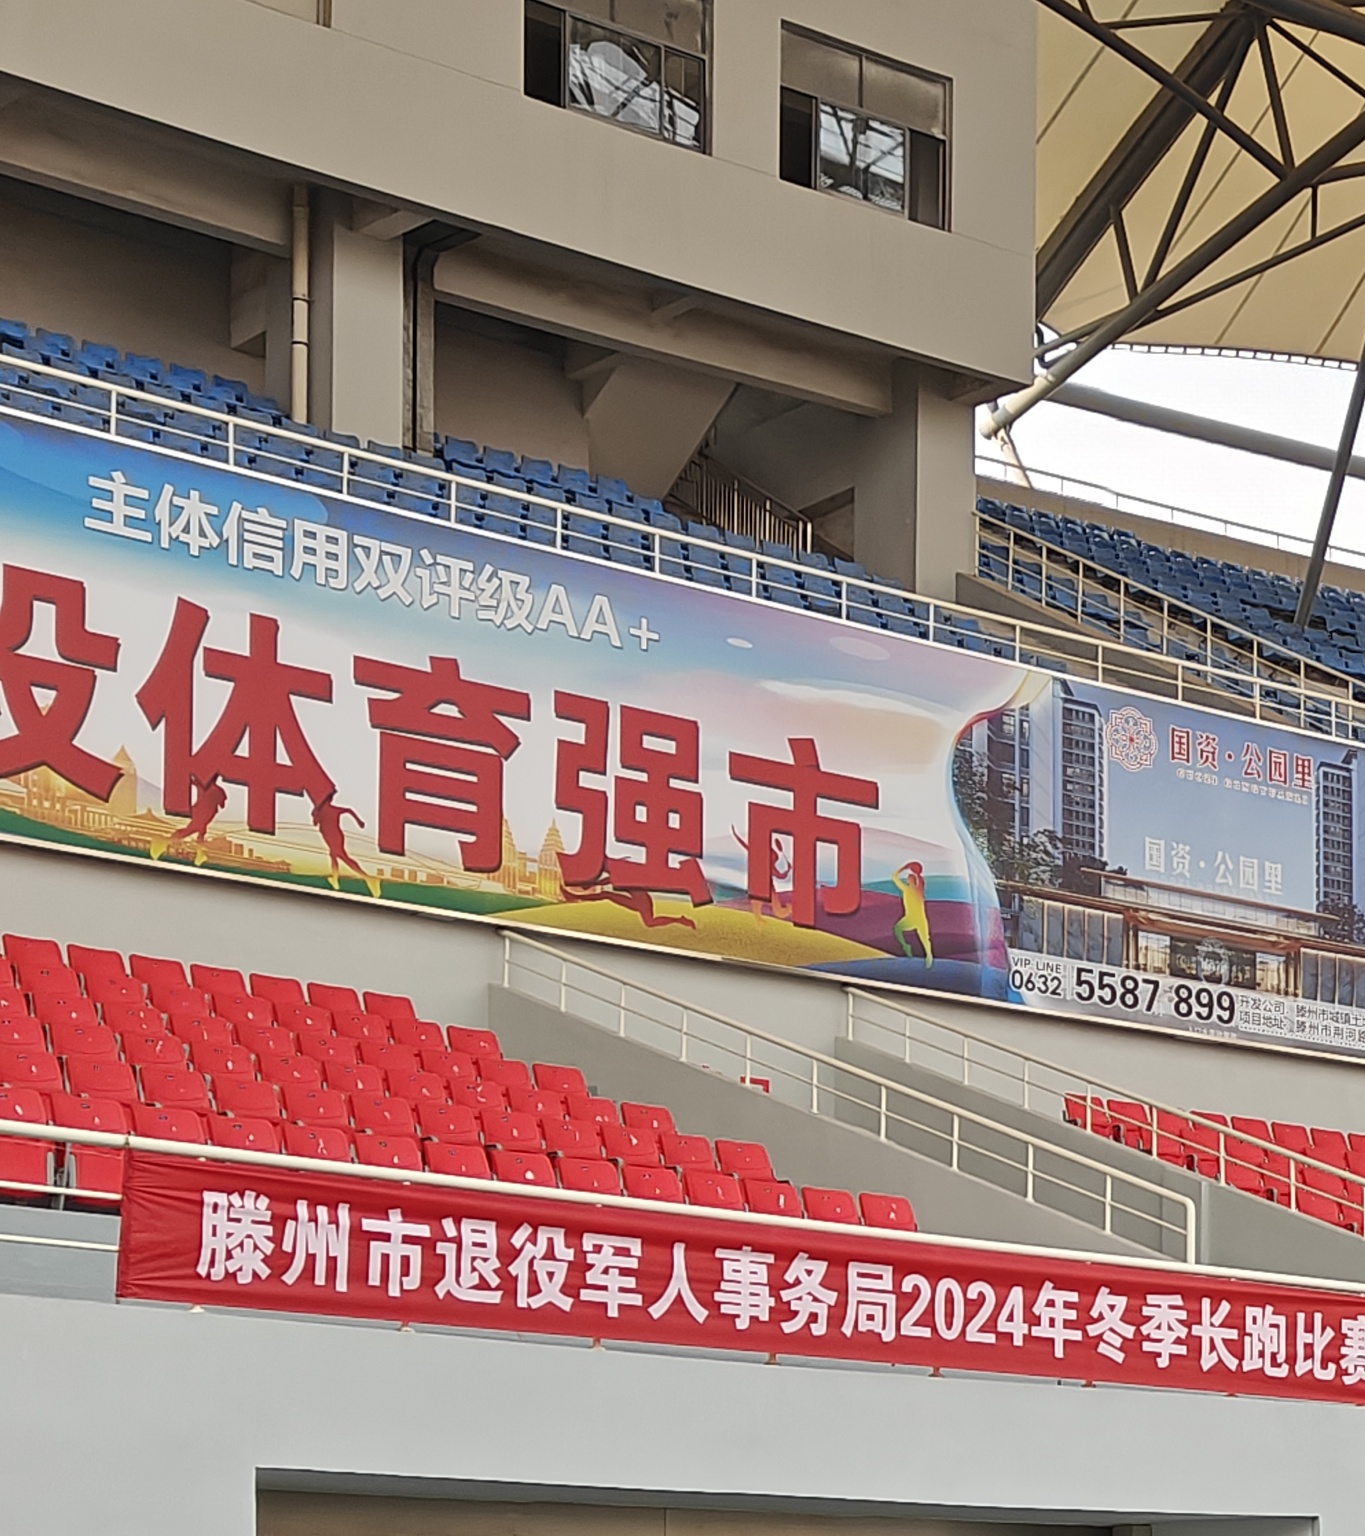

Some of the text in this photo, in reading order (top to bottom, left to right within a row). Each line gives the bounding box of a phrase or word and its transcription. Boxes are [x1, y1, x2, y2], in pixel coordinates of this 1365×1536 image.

[83, 470, 661, 651] 主体信用双评级AA+
[1012, 956, 1062, 974] VIP LINE
[1011, 966, 1235, 1025] 0632 5587 899
